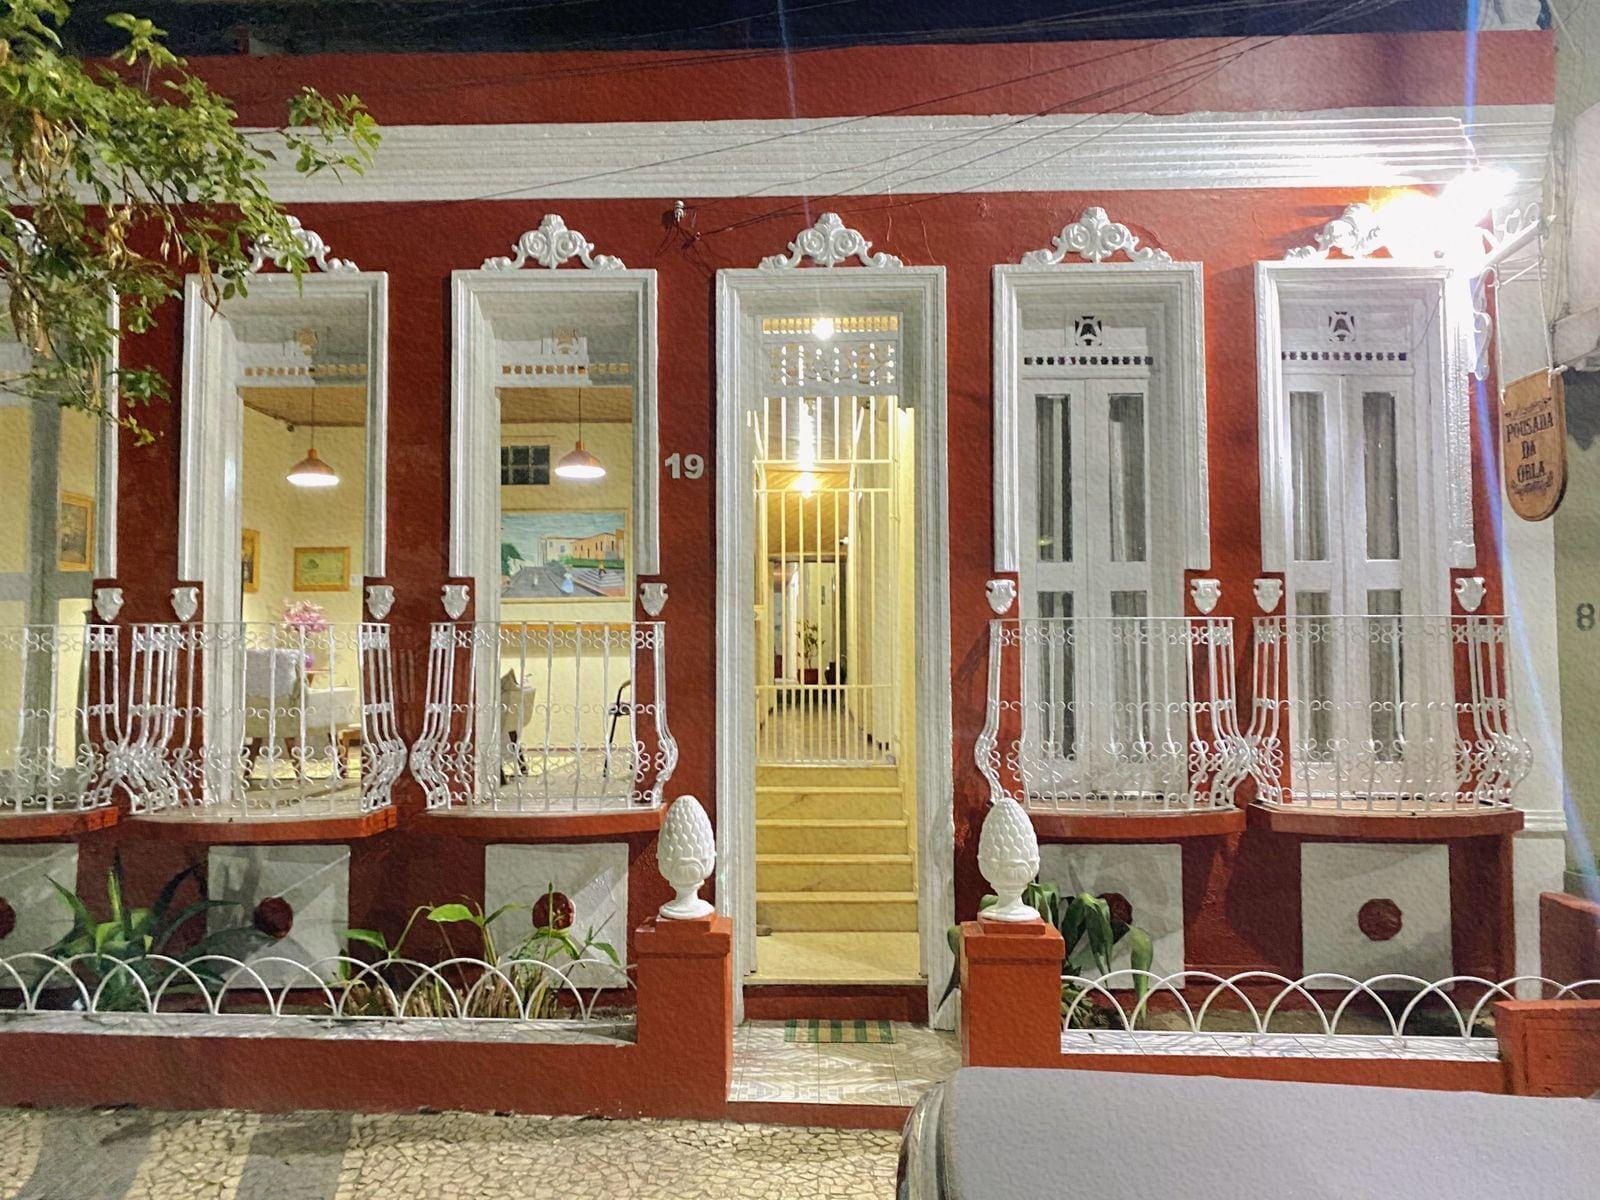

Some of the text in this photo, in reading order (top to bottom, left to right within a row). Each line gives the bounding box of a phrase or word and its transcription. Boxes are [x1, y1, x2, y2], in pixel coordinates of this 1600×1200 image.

[1505, 412, 1554, 442] POUSADA
[1521, 440, 1537, 460] DA
[664, 452, 705, 480] 19
[1516, 461, 1546, 483] ORLA
